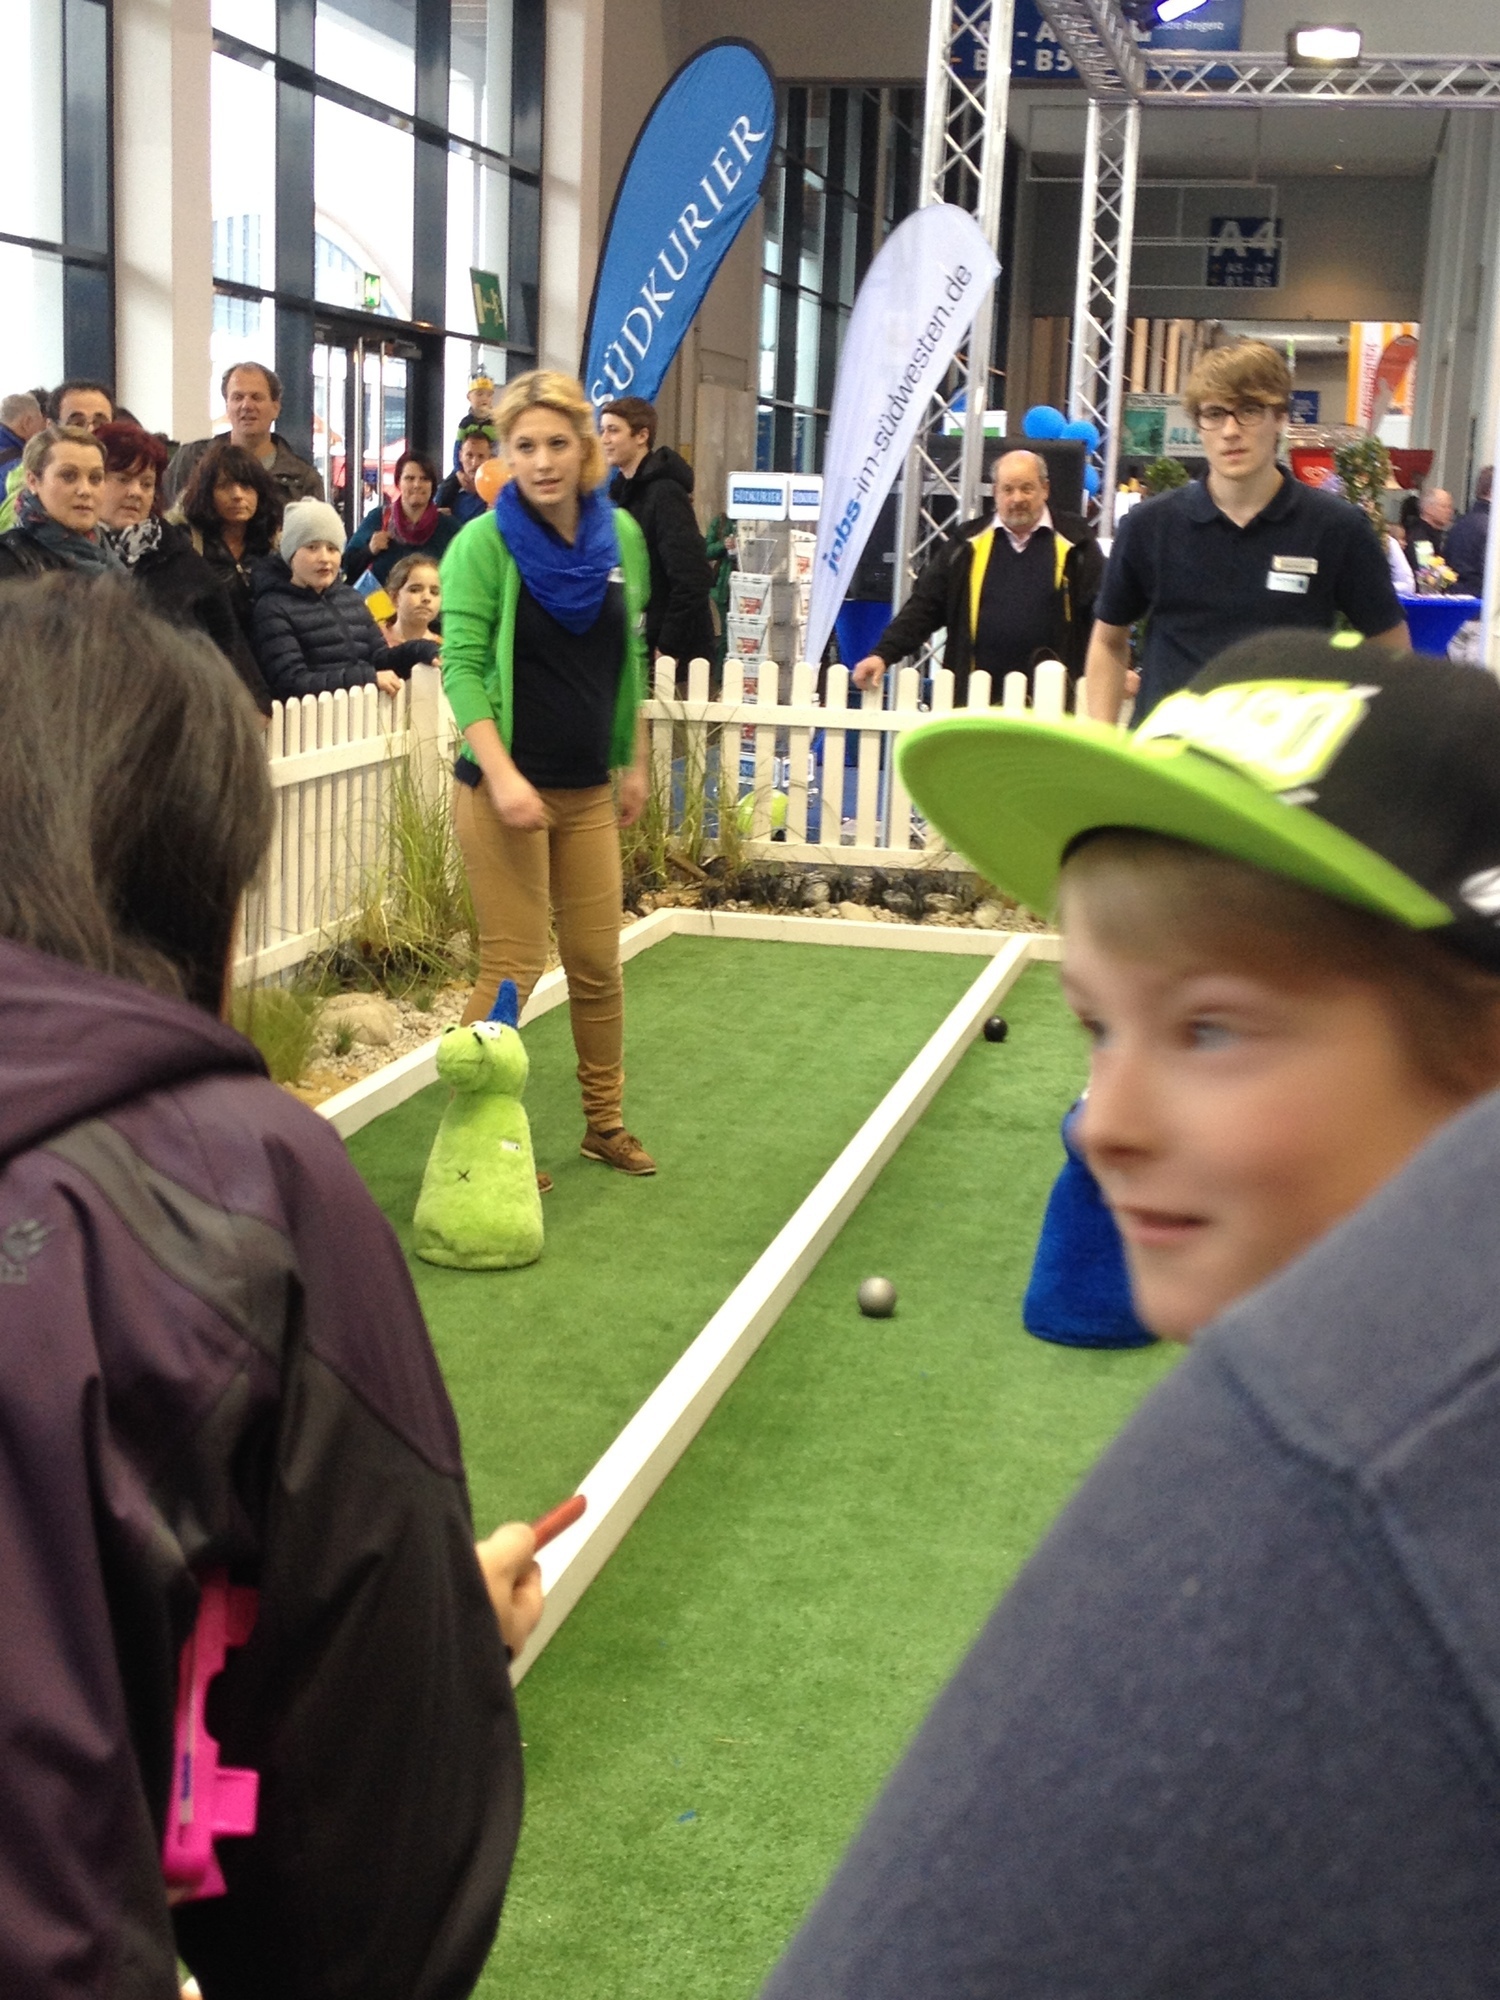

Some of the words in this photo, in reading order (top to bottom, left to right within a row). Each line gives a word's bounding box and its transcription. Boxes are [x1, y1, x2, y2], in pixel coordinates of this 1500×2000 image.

[1036, 49, 1073, 72] B5
[589, 114, 767, 408] SÜDKURIER
[1212, 220, 1277, 257] A4
[822, 264, 973, 577] jobs-im-südwesten.de
